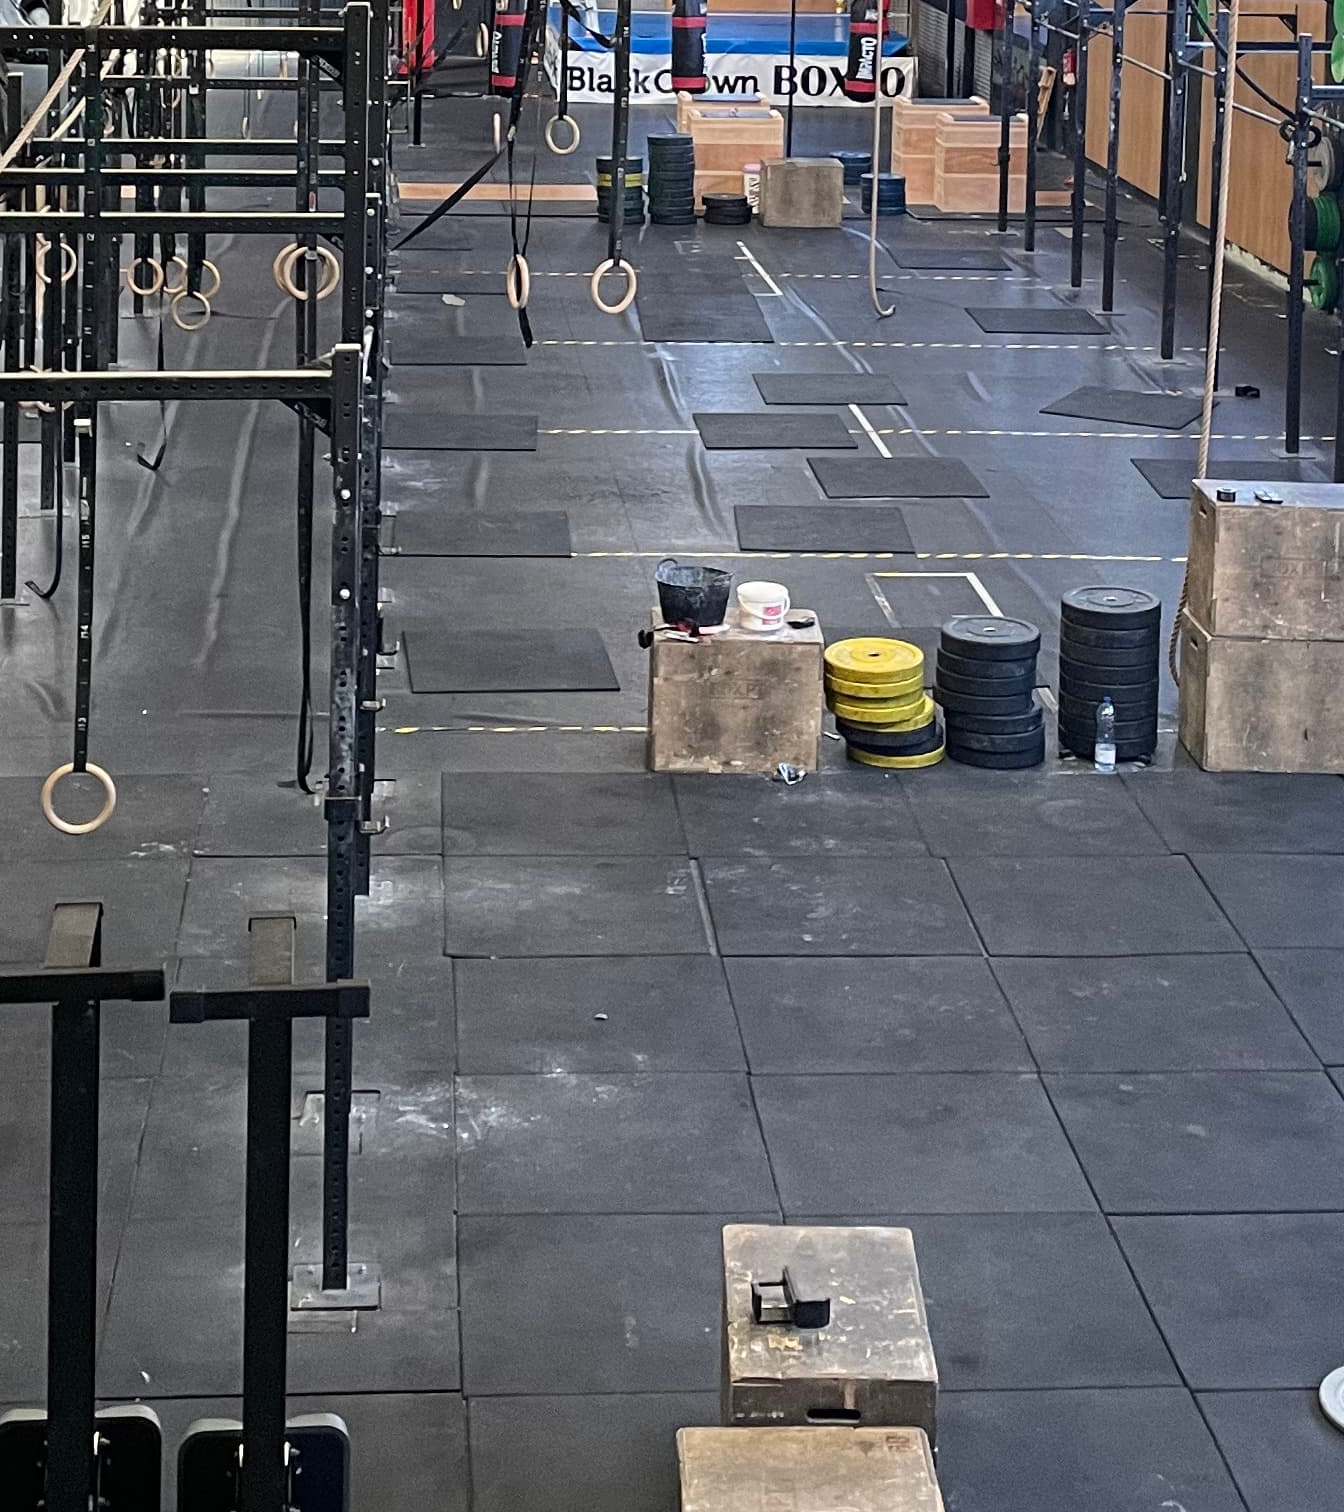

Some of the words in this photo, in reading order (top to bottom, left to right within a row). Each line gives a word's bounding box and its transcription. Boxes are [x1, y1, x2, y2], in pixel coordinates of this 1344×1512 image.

[567, 66, 650, 94] Blak
[654, 68, 760, 94] Cwn
[773, 65, 906, 98] BOXO
